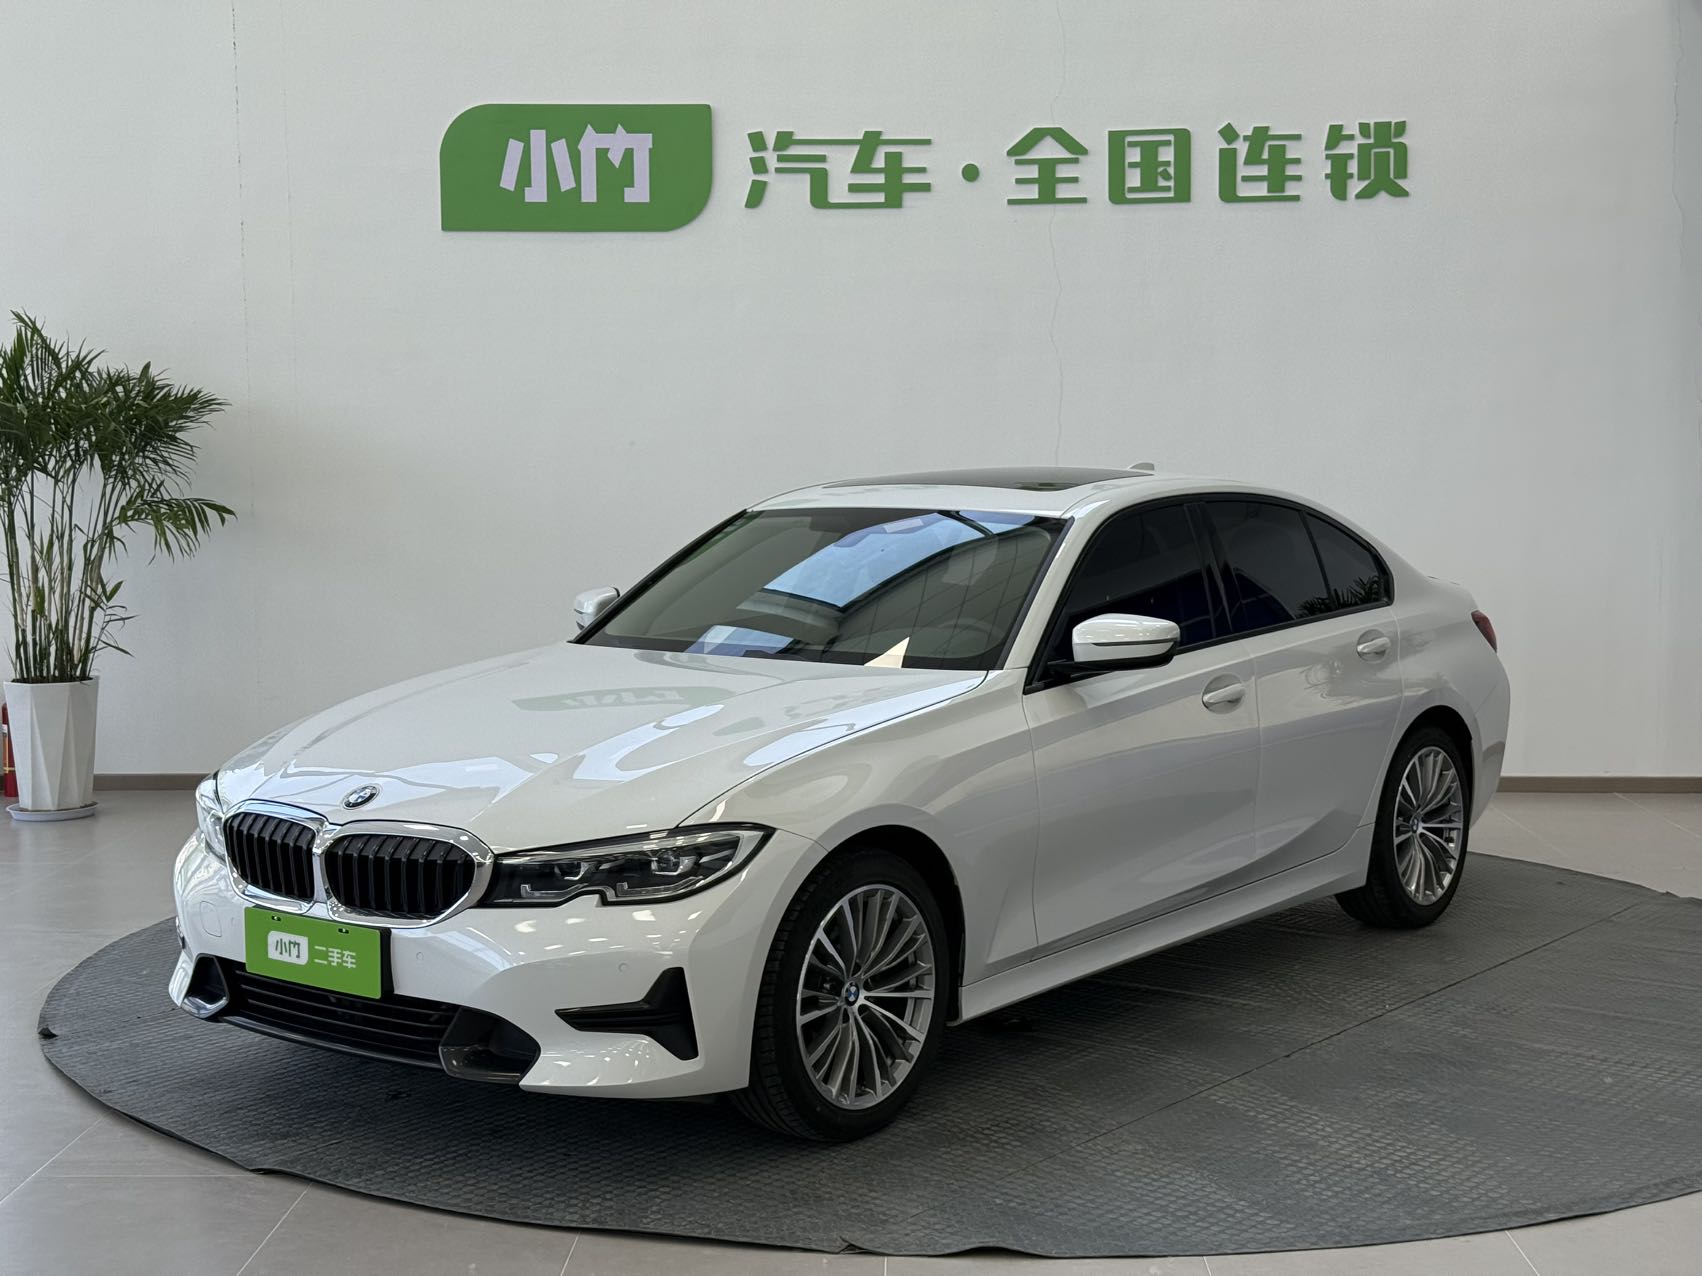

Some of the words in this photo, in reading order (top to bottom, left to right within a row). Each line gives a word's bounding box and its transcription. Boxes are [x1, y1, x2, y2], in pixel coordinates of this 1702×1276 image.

[499, 123, 653, 203] 小竹
[314, 945, 357, 969] 二手车
